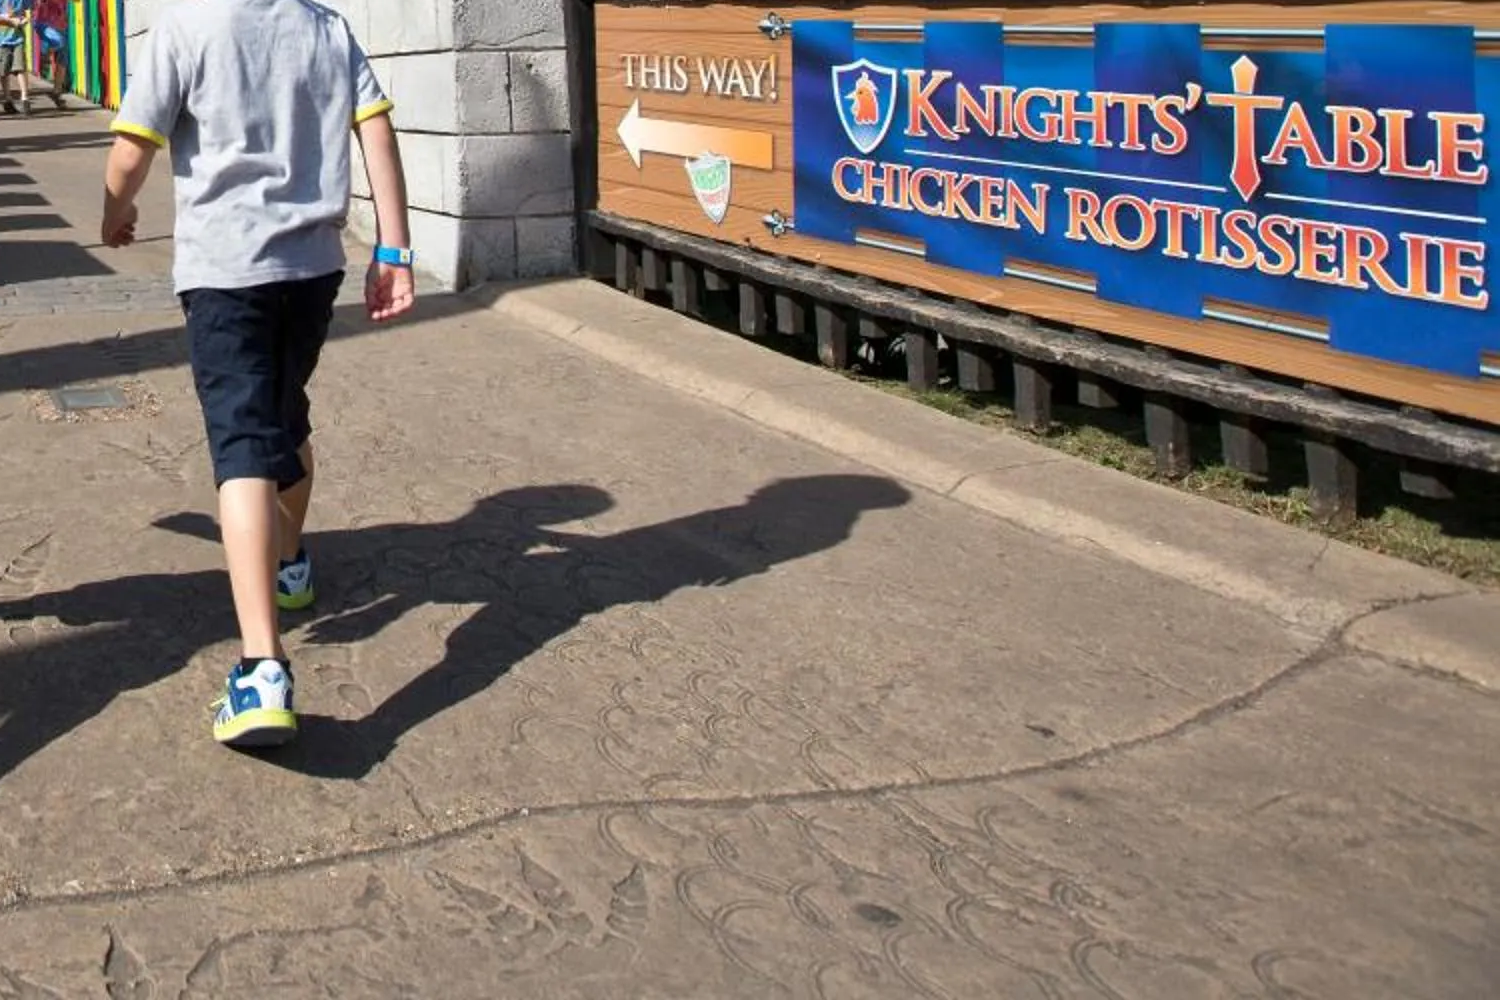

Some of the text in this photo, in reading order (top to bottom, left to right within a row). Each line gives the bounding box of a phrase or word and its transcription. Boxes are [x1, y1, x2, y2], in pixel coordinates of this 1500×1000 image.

[620, 53, 778, 100] THIS WAY!
[902, 54, 1489, 202] KNIGHTS' TABLE
[831, 157, 1489, 310] CHICKEN ROTISSERIE
